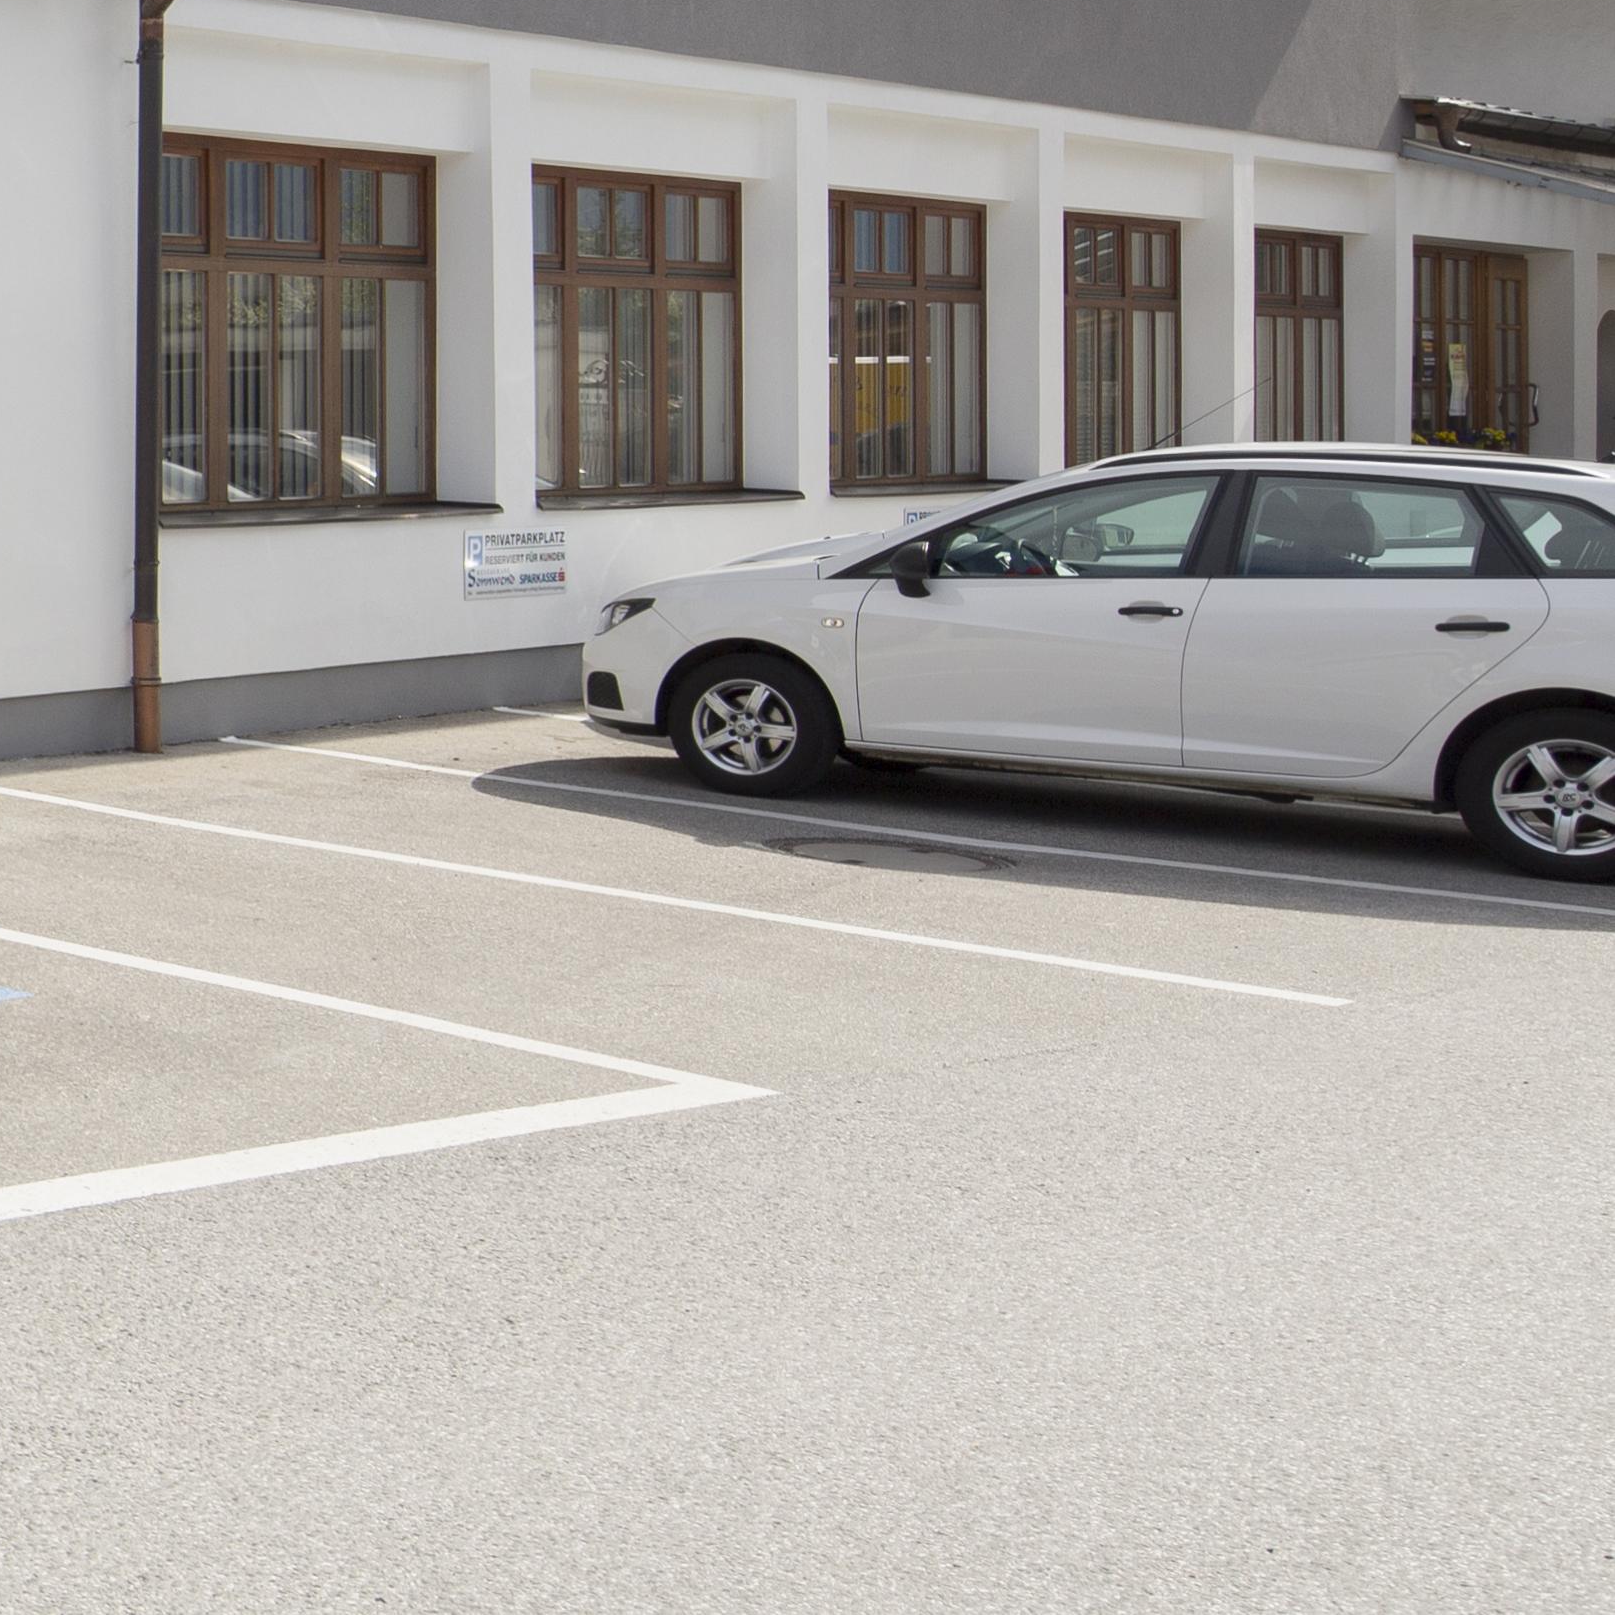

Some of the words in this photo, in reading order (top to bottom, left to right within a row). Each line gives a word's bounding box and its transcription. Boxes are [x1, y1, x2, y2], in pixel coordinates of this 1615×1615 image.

[485, 531, 565, 546] PRIVATPARKPLATZ
[485, 554, 524, 566] RESERVIERT
[525, 551, 538, 563] FÜR
[539, 552, 566, 562] KUNDEN
[519, 571, 558, 585] SPARKASSE
